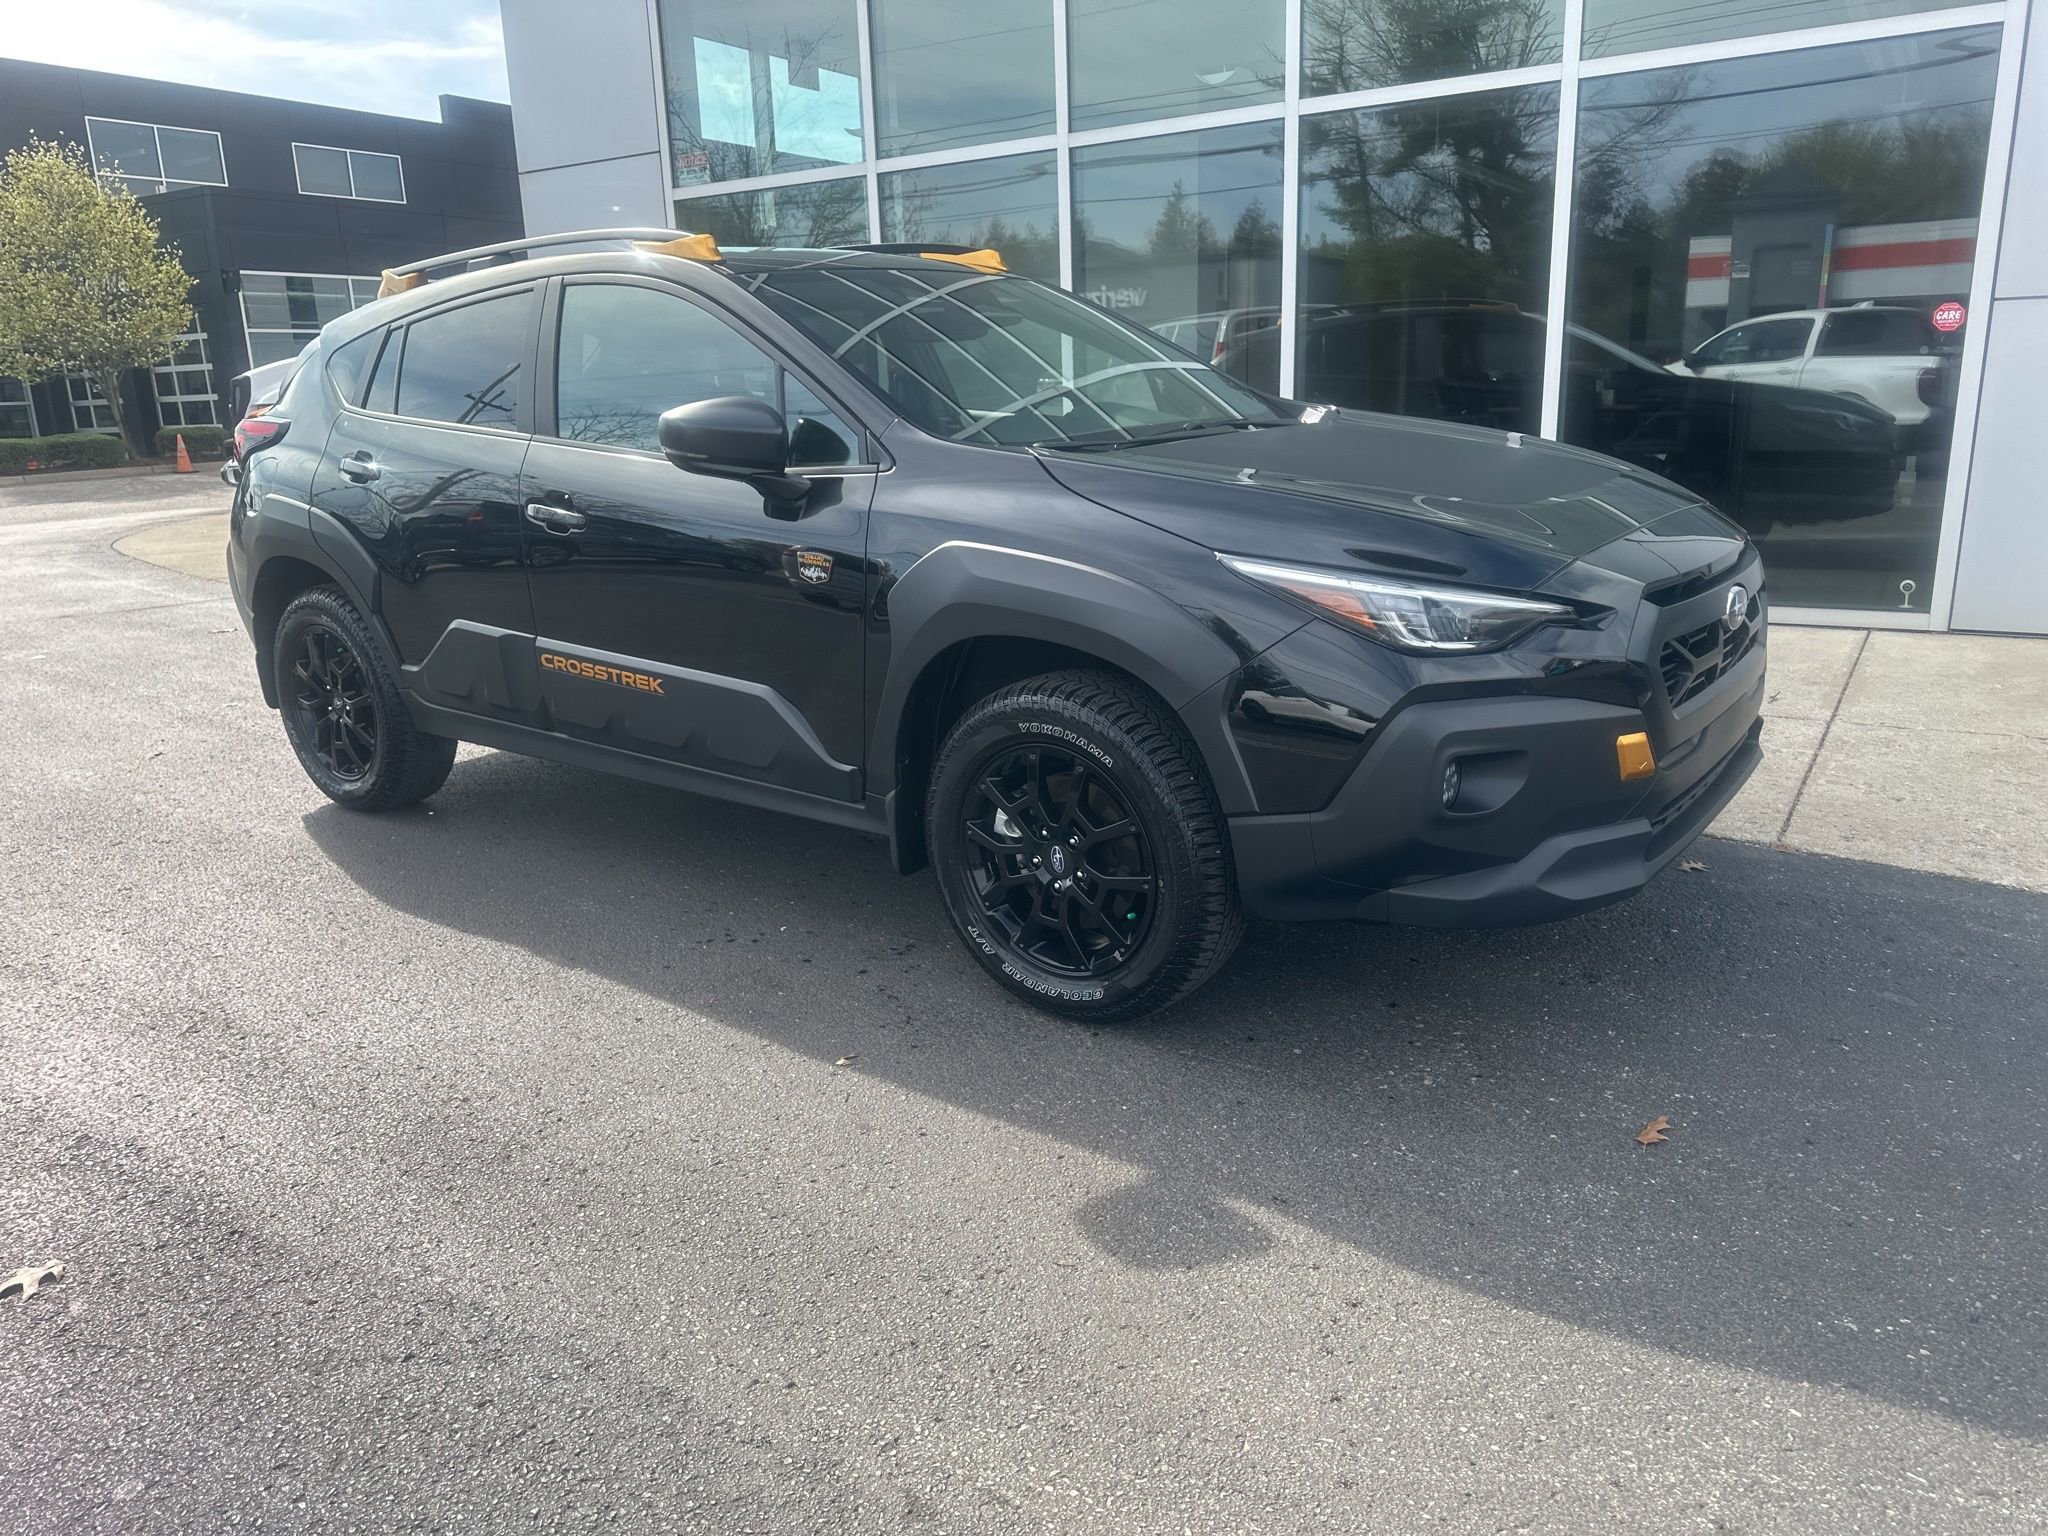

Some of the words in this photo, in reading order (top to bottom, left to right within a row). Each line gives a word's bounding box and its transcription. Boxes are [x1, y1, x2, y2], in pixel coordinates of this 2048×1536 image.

[1936, 310, 1962, 320] CARE
[540, 653, 665, 694] CROSSTREK
[1018, 722, 1113, 768] YOKOHAMA
[967, 925, 996, 955] A/T
[1001, 961, 1104, 1001] GEOLANDAR
